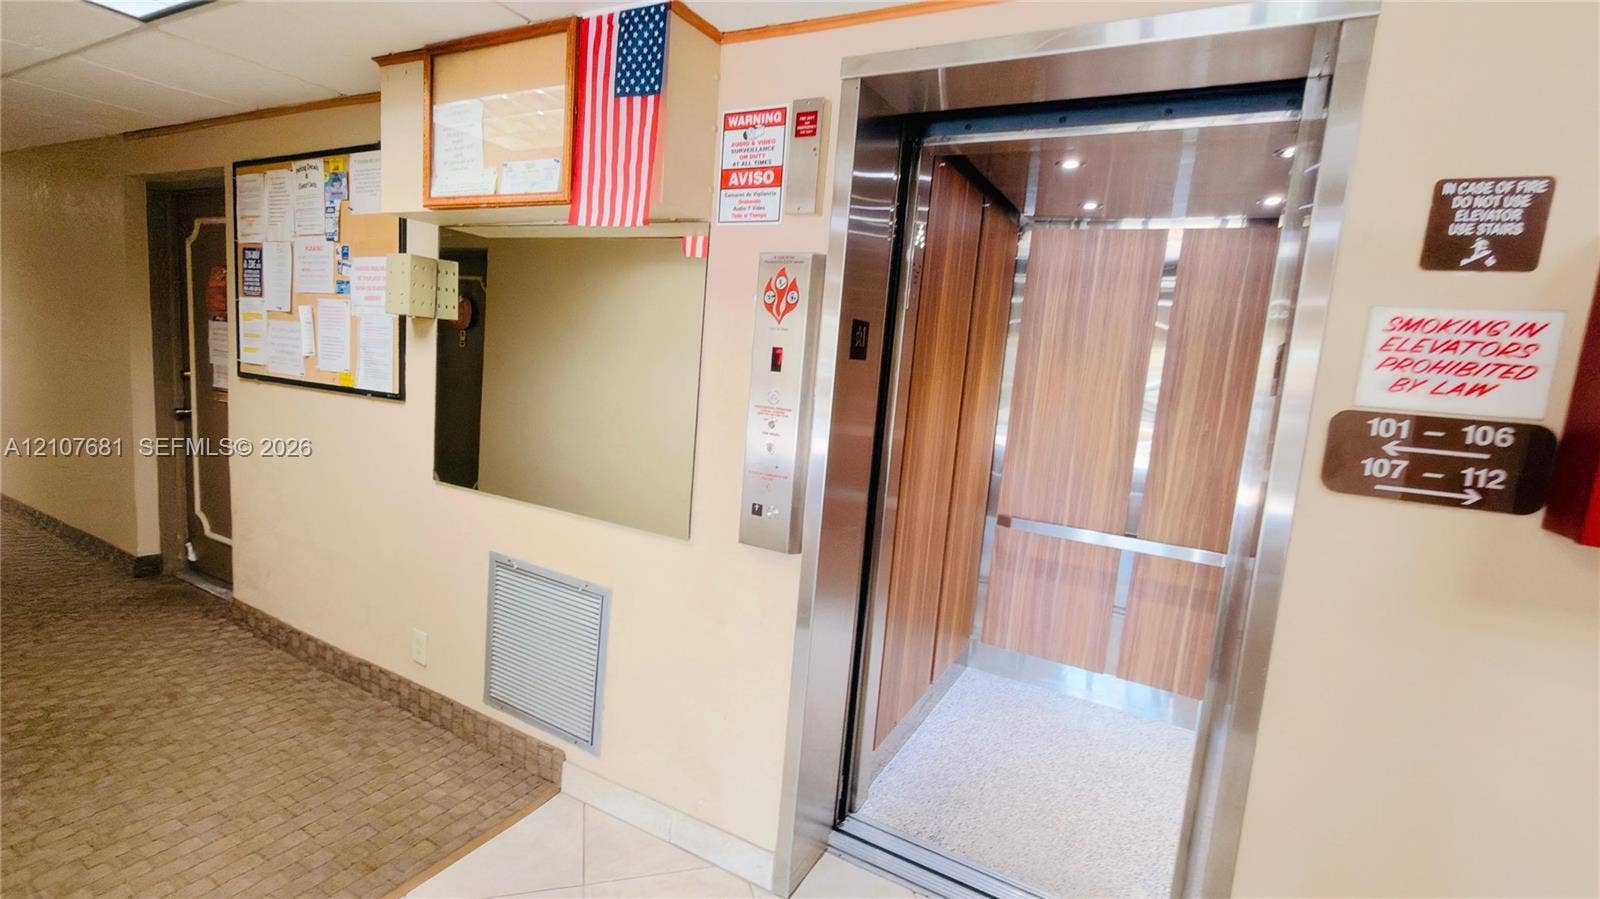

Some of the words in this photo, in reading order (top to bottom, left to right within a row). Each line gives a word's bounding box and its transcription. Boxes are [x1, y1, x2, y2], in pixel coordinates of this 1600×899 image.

[728, 111, 782, 128] WARNING
[731, 146, 775, 154] SURVEILLANCE
[728, 170, 775, 186] AVISO
[1442, 182, 1458, 196] IN
[1458, 181, 1495, 195] CASE
[1495, 180, 1517, 194] OF
[1516, 179, 1550, 193] FIRE
[1451, 195, 1473, 209] DO
[1473, 194, 1503, 208] NOT
[1503, 194, 1533, 208] USE
[1454, 208, 1524, 223] ELEVATOR
[1448, 222, 1476, 236] USE
[1475, 222, 1525, 236] STAIRS
[1383, 316, 1510, 337] SMOKING
[1510, 320, 1549, 338] IN
[1378, 336, 1540, 359] ELEVATORS
[1375, 356, 1538, 380] PROHIBITED
[1387, 377, 1428, 393] BY
[1429, 381, 1500, 397] LAW
[1367, 417, 1411, 439] 101
[1461, 424, 1517, 448] 106
[1361, 457, 1410, 479] 107
[1460, 466, 1508, 490] 112
